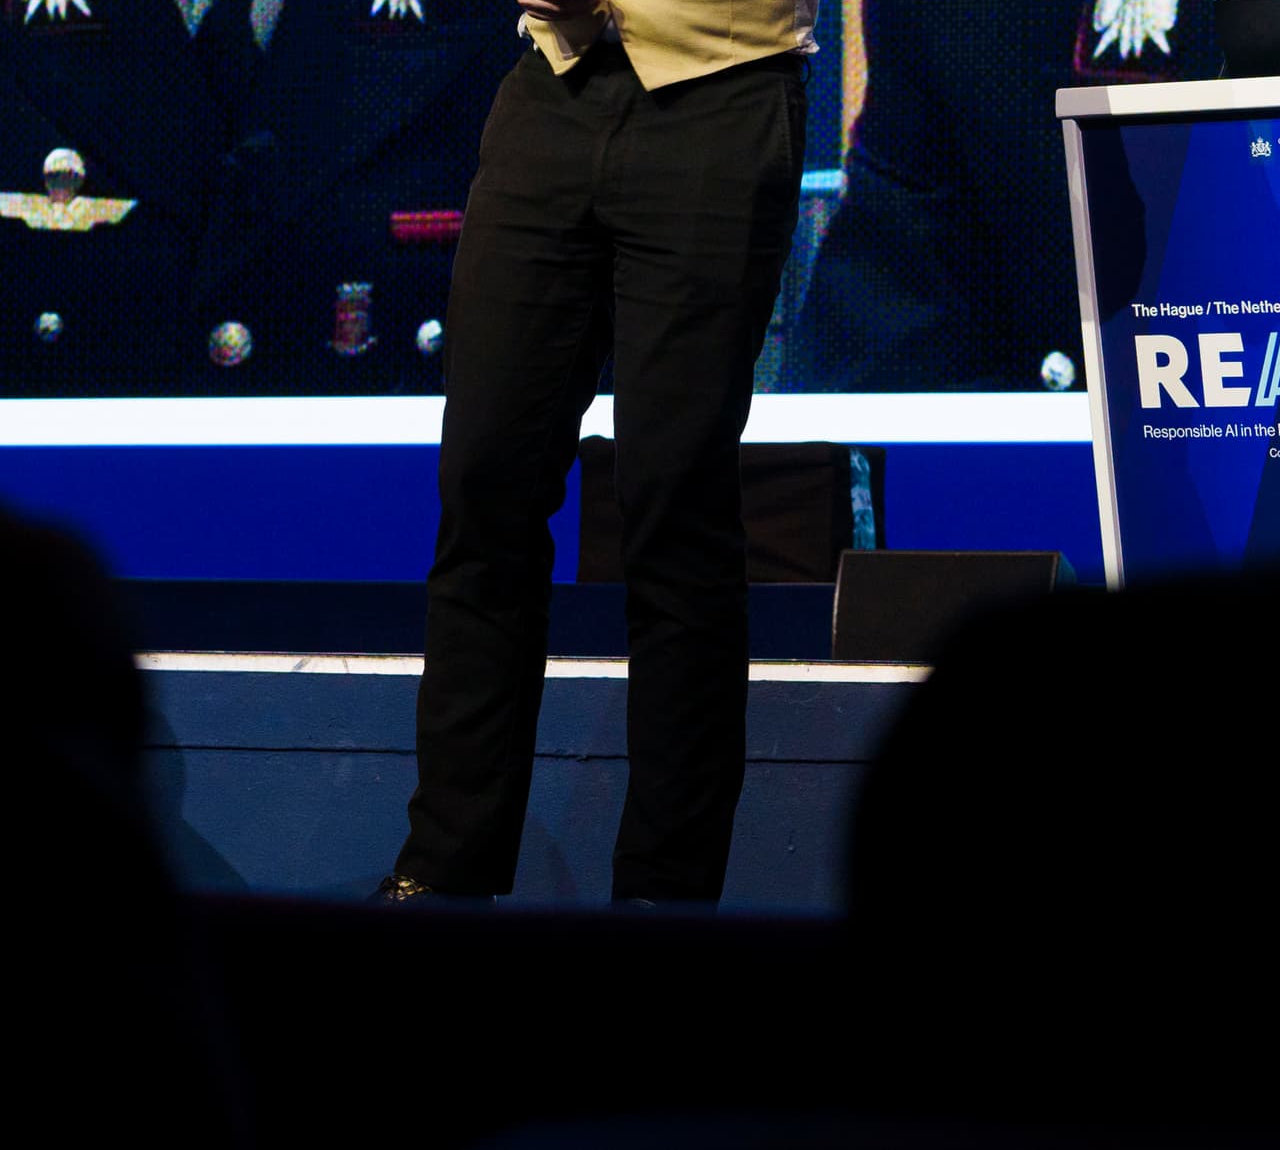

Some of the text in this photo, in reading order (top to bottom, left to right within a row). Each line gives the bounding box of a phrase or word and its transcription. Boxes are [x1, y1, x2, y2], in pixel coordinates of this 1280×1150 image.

[1131, 303, 1158, 317] The
[1159, 303, 1204, 319] Hague
[1206, 301, 1212, 315] /
[1213, 301, 1240, 315] The
[1143, 424, 1223, 441] Responsible
[1225, 424, 1239, 437] AI
[1240, 423, 1253, 437] in
[1254, 423, 1276, 437] the
